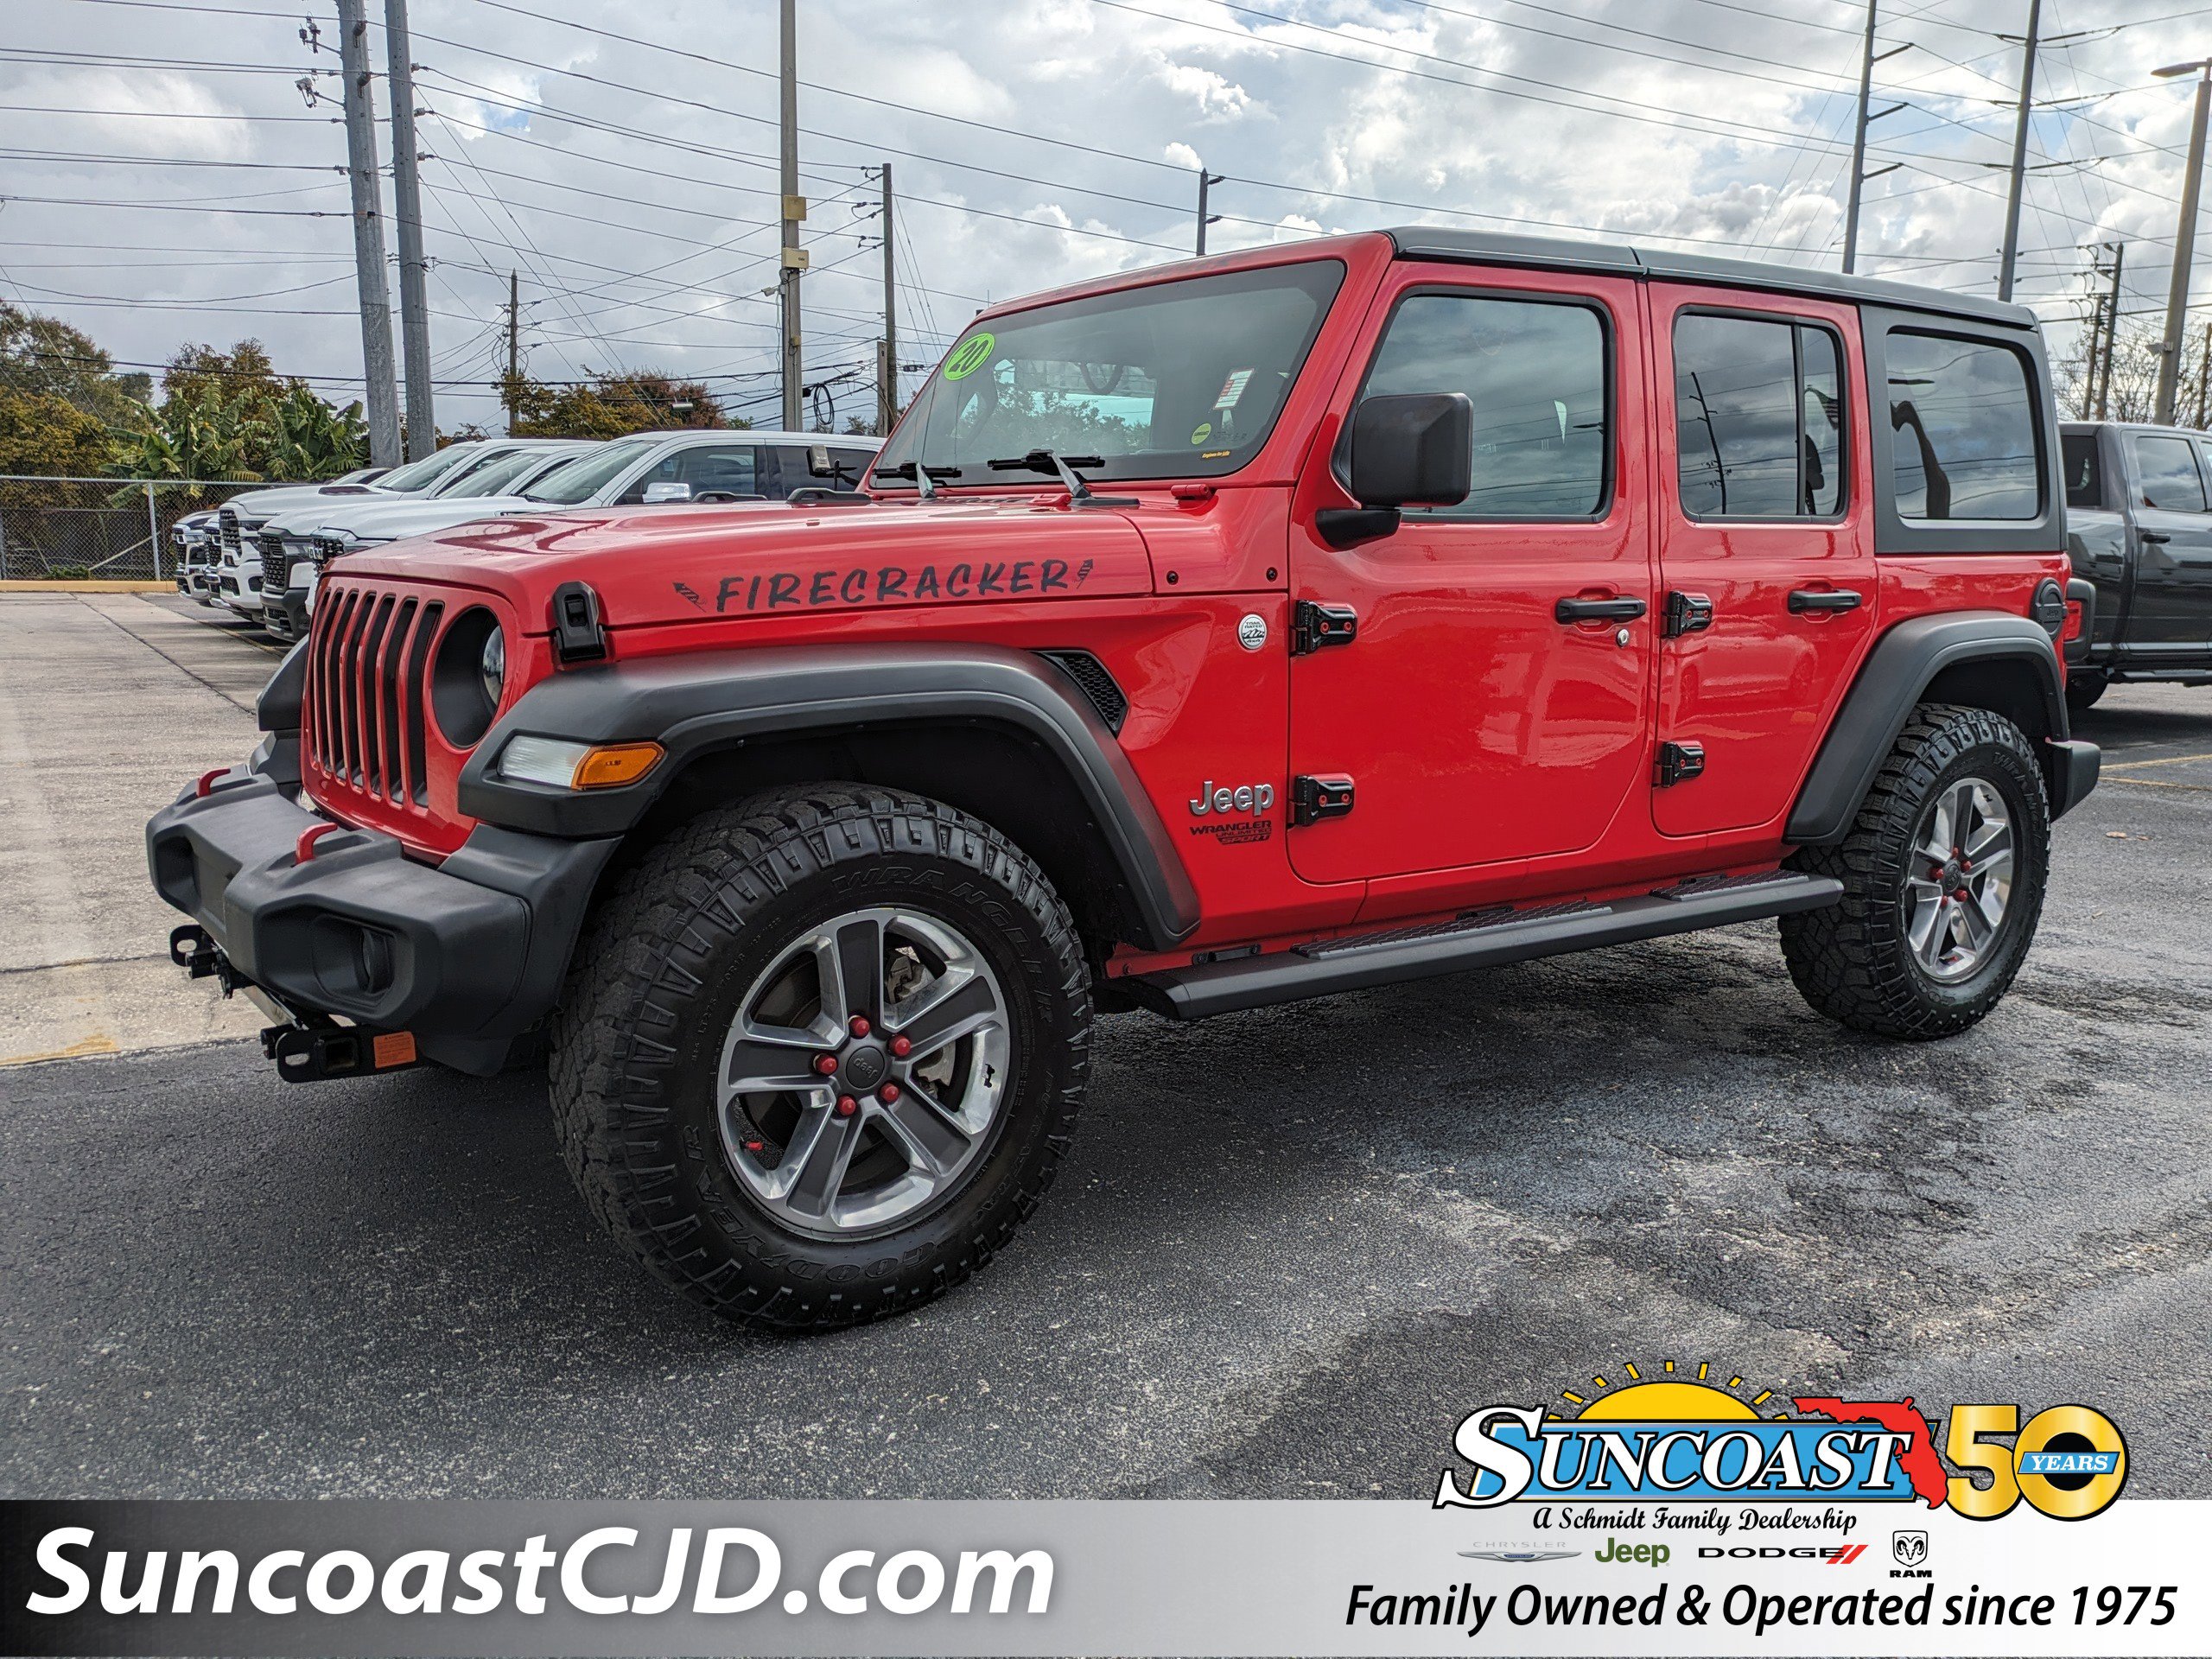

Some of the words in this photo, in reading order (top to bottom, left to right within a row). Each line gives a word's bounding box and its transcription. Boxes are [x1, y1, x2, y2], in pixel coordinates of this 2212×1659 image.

[947, 340, 989, 372] 20
[716, 559, 1069, 613] FIRECRACKER
[1189, 780, 1274, 817] Jeep
[1189, 820, 1272, 836] WRANGLER
[854, 1057, 878, 1078] Jeep
